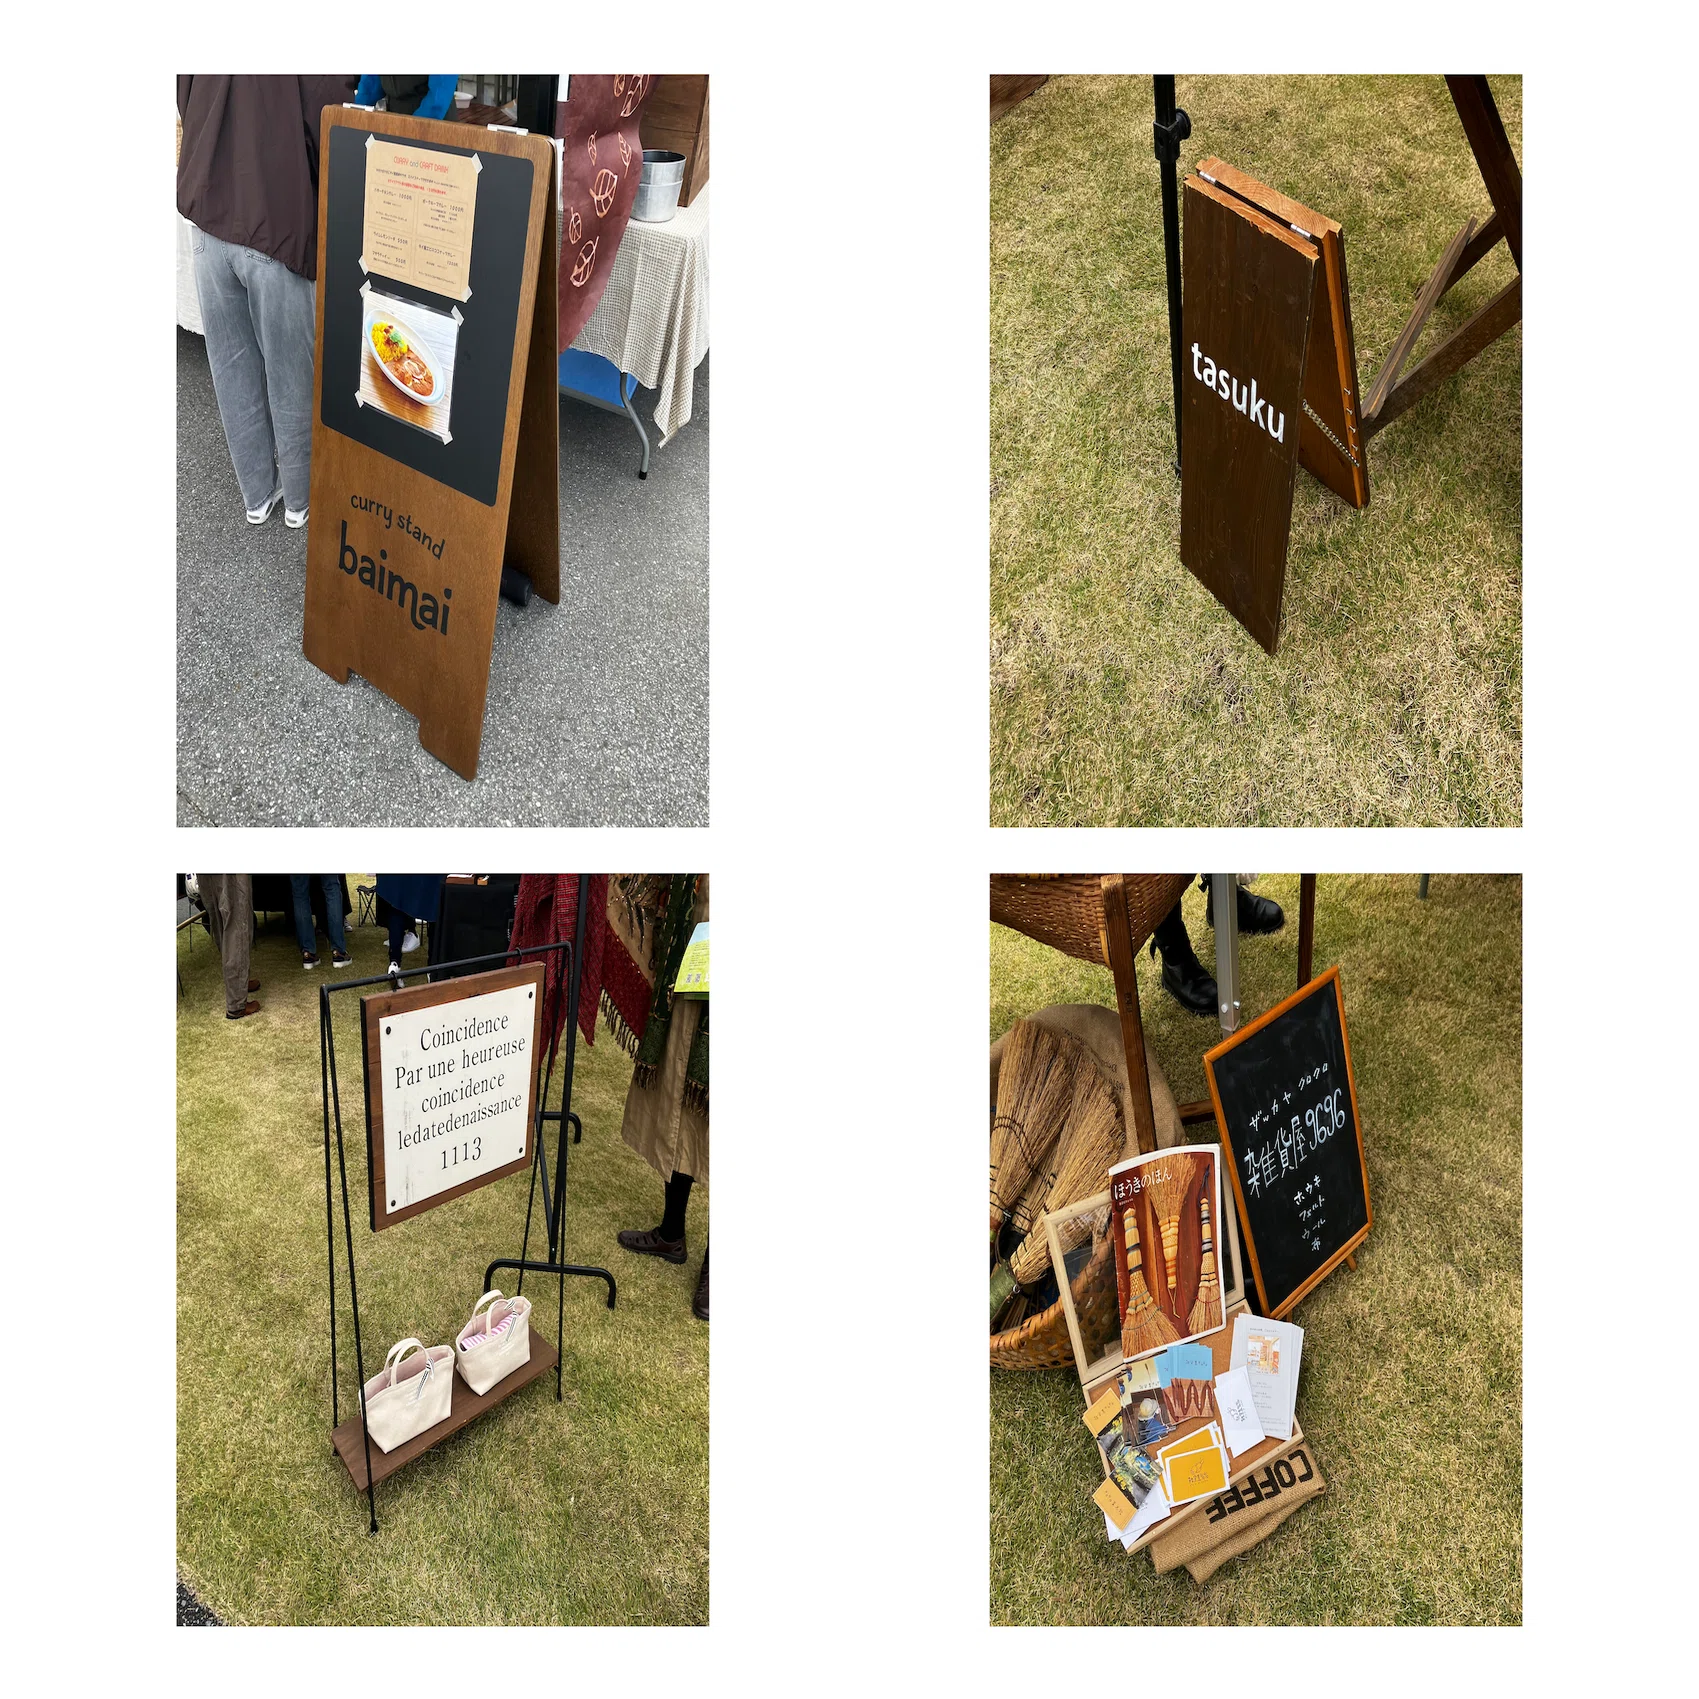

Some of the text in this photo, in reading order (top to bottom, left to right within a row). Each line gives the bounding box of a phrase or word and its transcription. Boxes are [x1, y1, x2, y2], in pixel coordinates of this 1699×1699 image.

[1191, 342, 1285, 444] tasuku
[350, 495, 446, 560] curry stand
[339, 519, 452, 636] baimai
[420, 1014, 509, 1051] Coincidence
[395, 1037, 526, 1090] Par une heureuse
[421, 1073, 505, 1113] coincidence
[398, 1094, 522, 1150] ledatedenaissance
[441, 1136, 482, 1171] 1113
[1114, 1166, 1173, 1200] ほうきのほん
[1293, 1174, 1321, 1206] ホウキ
[1299, 1194, 1325, 1222] フェルト
[1301, 1218, 1326, 1240] ウール
[1205, 1449, 1314, 1525] COFFEE
